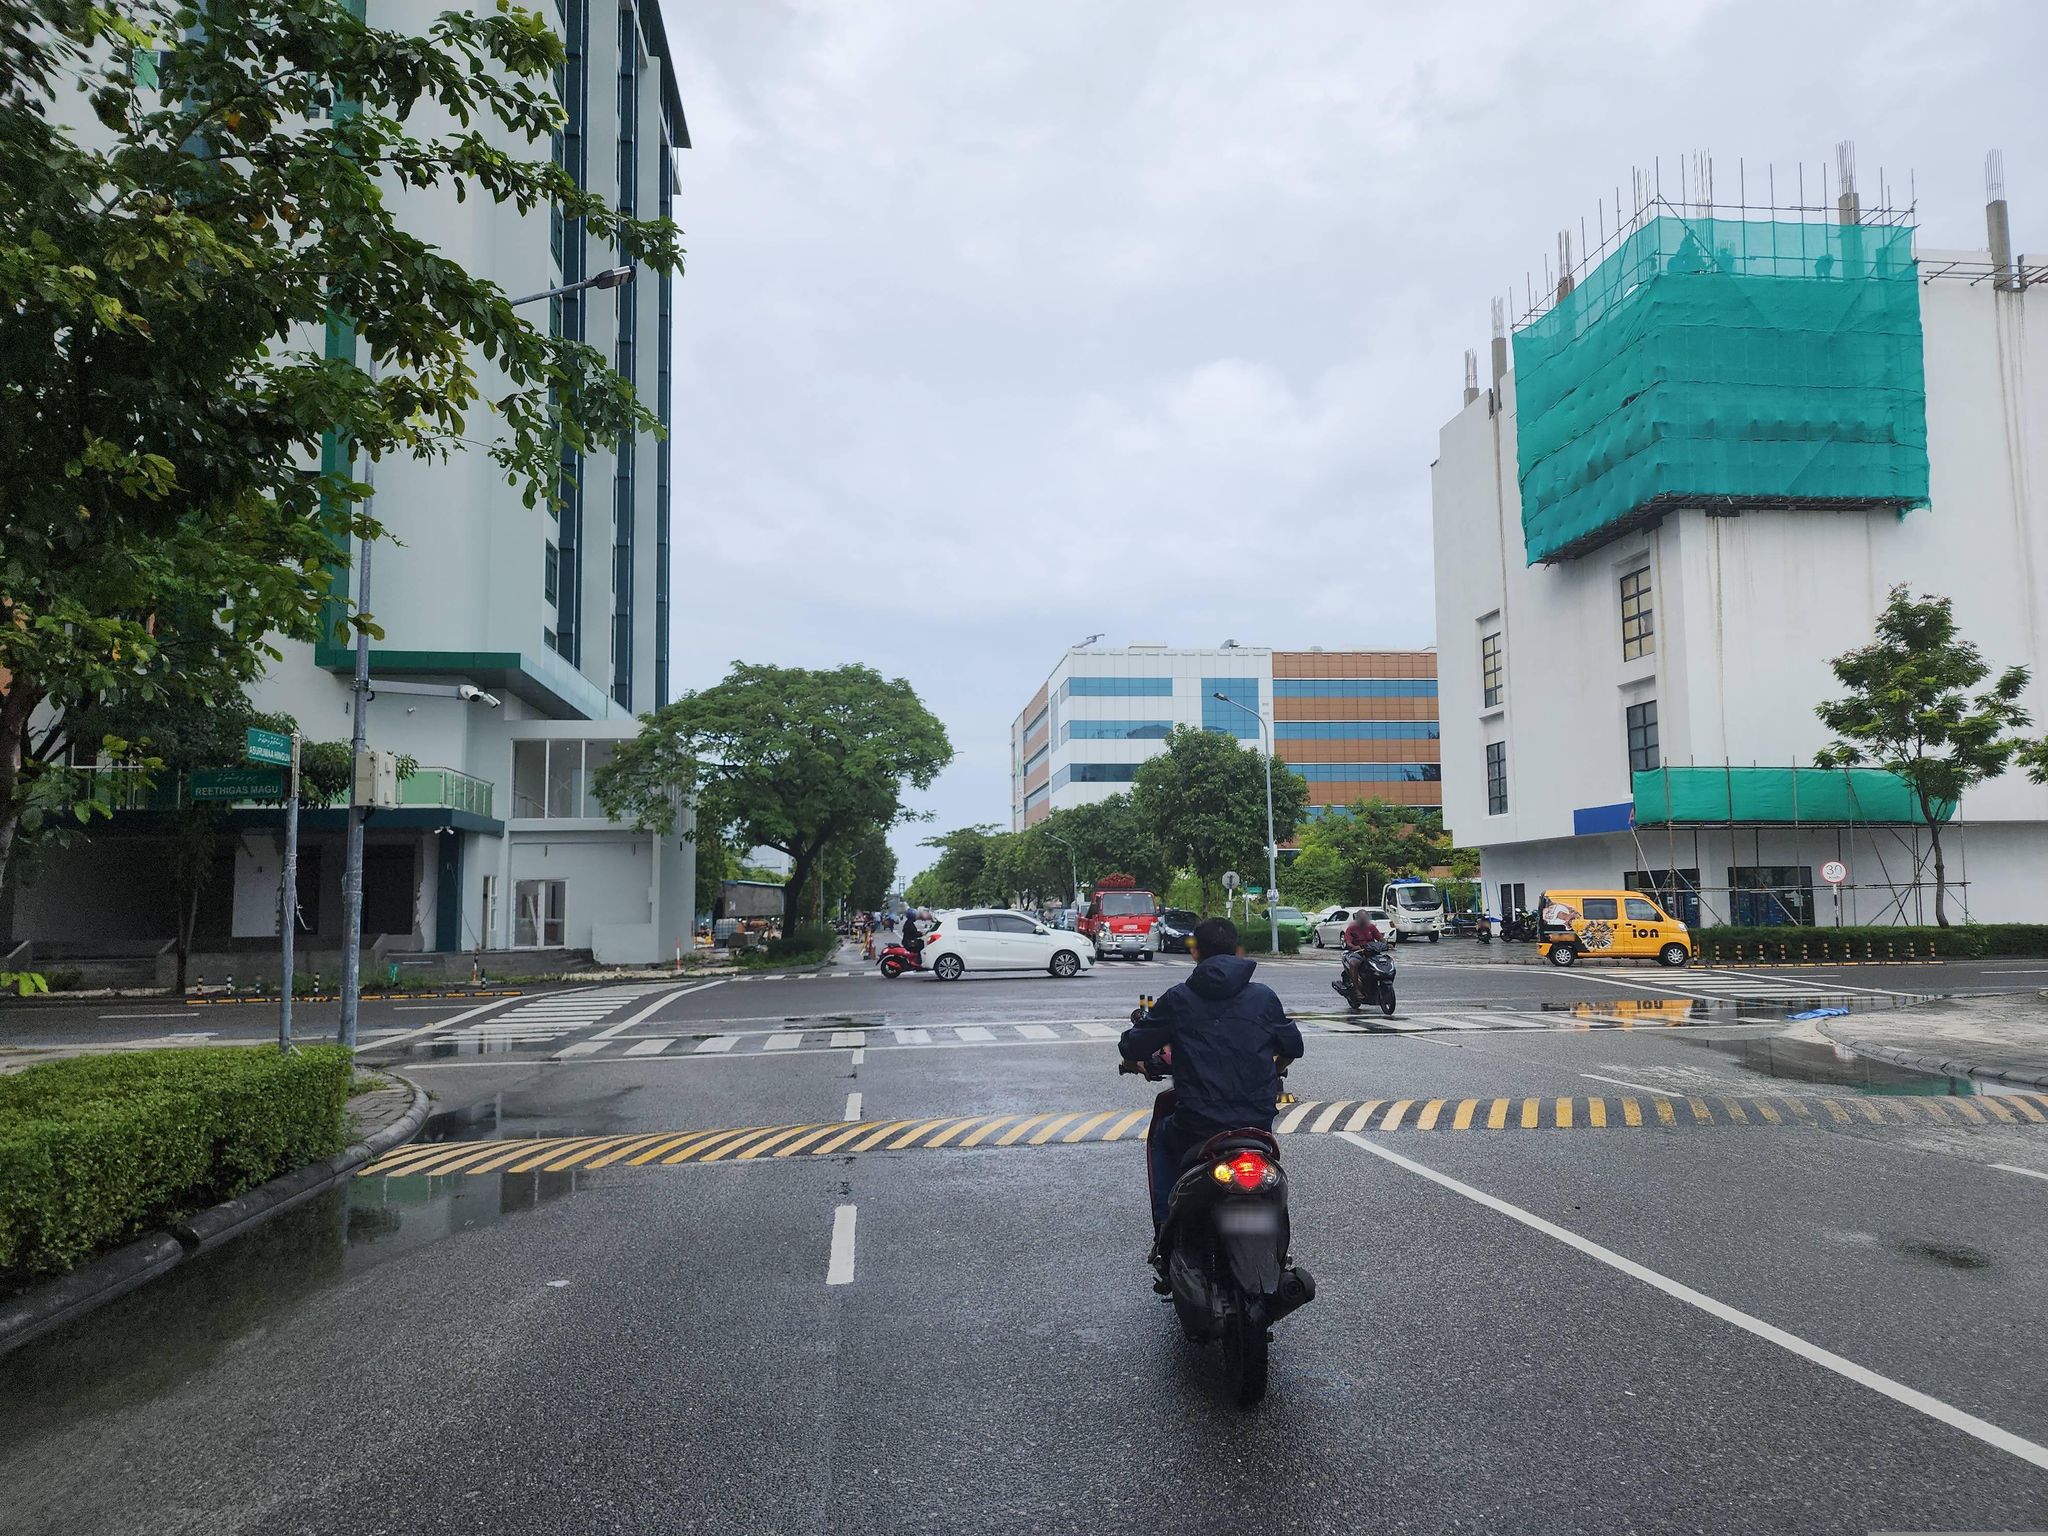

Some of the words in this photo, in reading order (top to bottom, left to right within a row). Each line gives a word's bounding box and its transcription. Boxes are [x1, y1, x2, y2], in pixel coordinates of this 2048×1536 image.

[195, 786, 249, 796] REETHIGAS
[250, 785, 279, 794] MAGU
[1825, 864, 1842, 875] 30
[1633, 925, 1659, 938] ion
